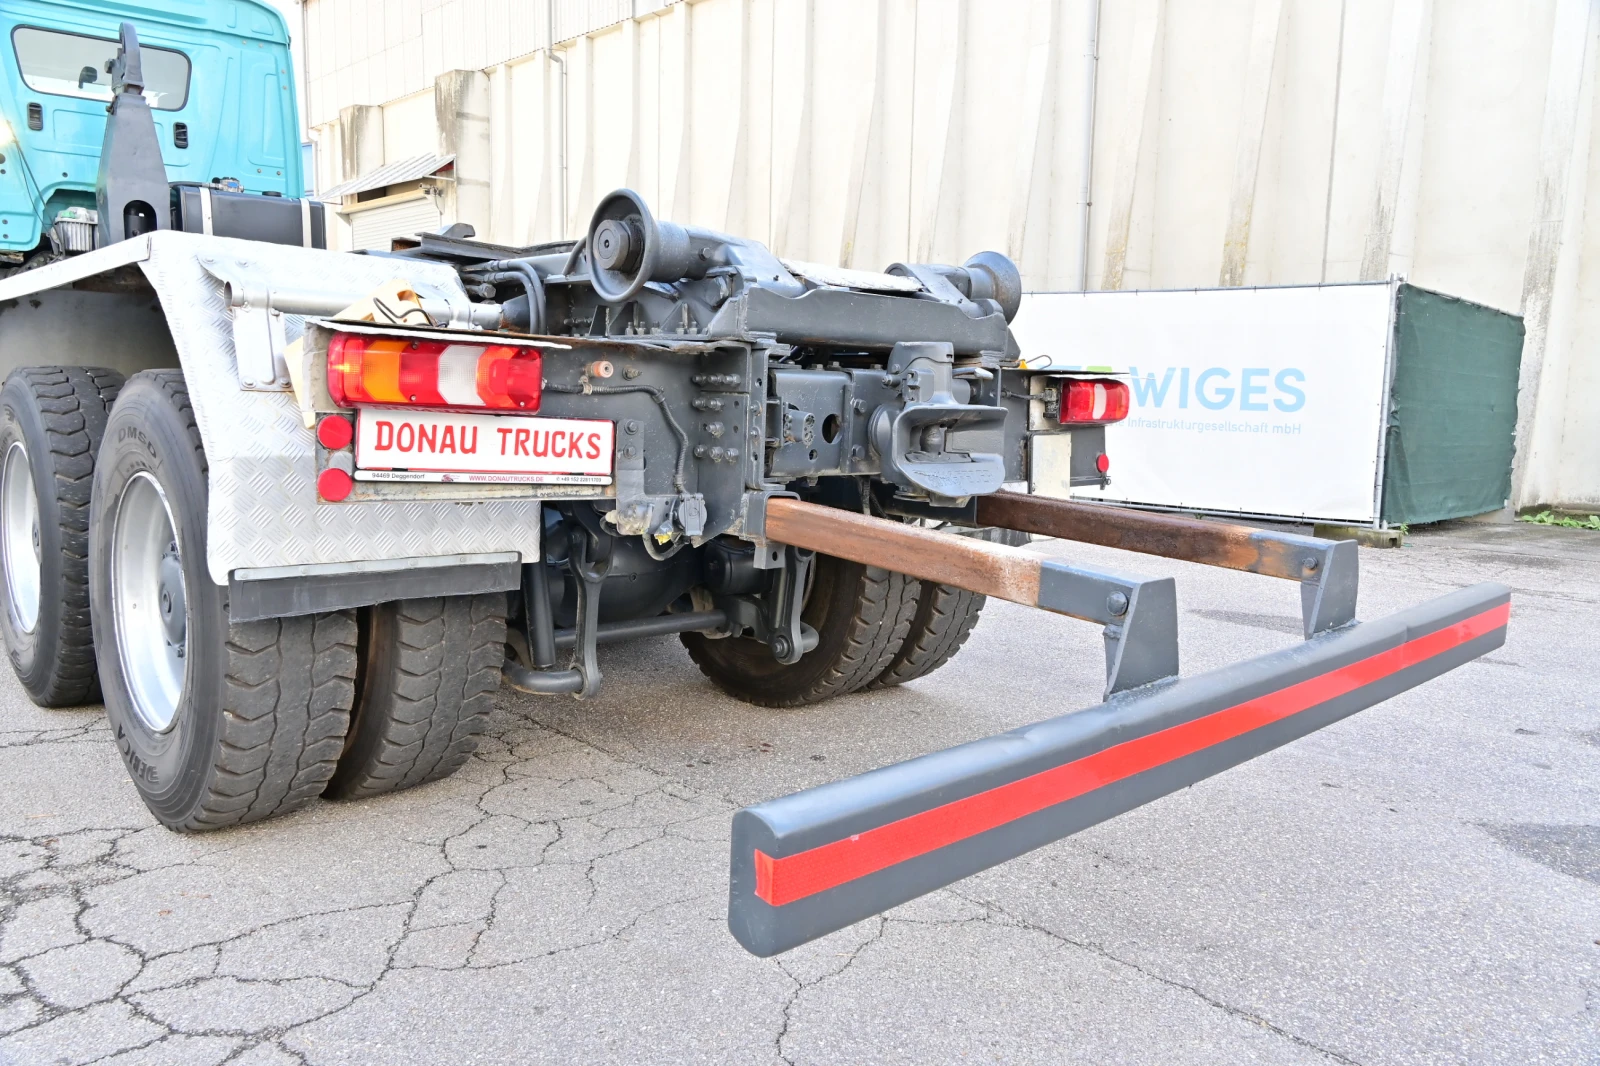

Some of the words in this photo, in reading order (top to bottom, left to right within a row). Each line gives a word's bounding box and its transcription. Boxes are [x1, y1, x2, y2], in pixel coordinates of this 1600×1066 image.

[1128, 366, 1306, 413] WIGES
[374, 420, 478, 455] DONAU
[496, 427, 601, 460] TRUCKS
[1127, 417, 1269, 434] Infrastrukturgesellschaft
[1272, 423, 1302, 435] mbH
[468, 475, 544, 483] WWW.DONAUTRUCKS.DE
